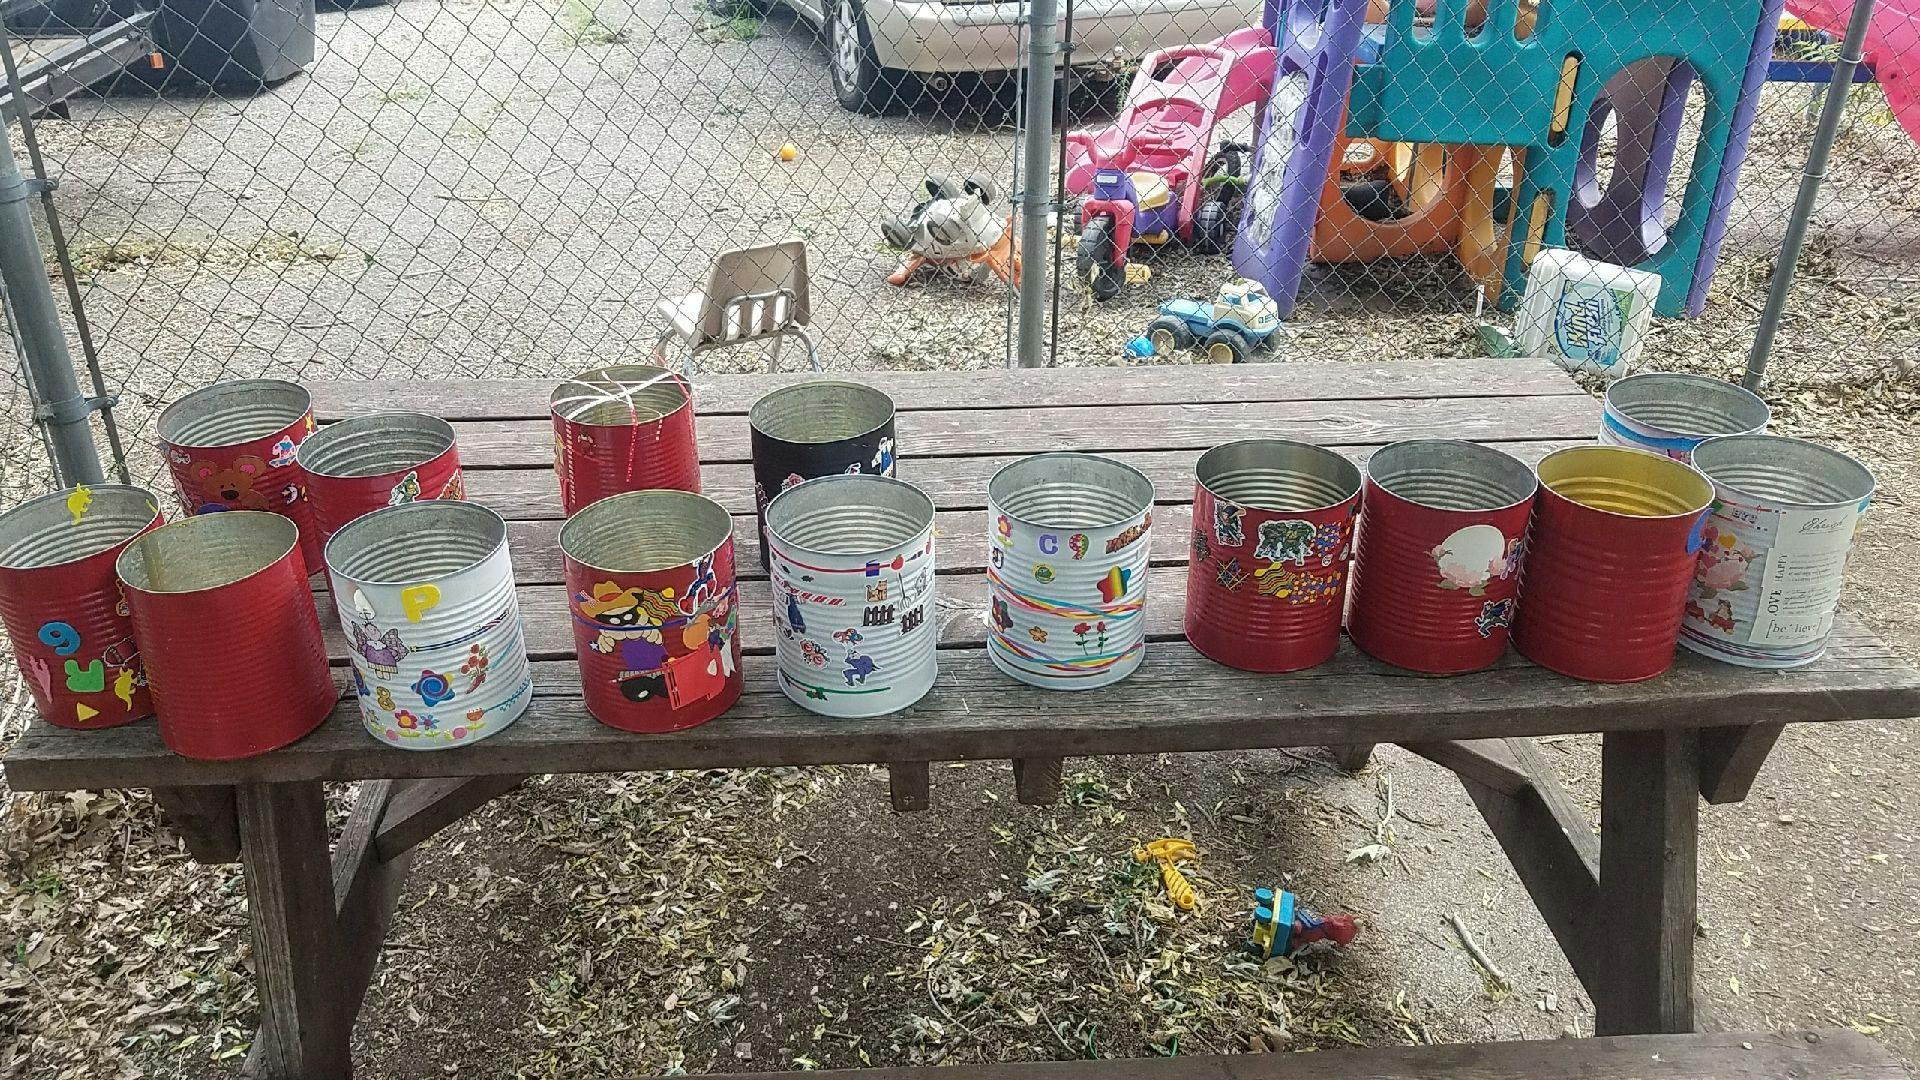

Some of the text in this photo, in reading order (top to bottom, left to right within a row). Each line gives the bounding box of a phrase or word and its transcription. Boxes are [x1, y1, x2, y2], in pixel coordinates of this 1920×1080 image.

[1584, 299, 1607, 347] Fresh
[1039, 534, 1058, 554] C
[401, 583, 441, 624] P
[1767, 590, 1782, 616] OVE
[38, 621, 81, 656] 9
